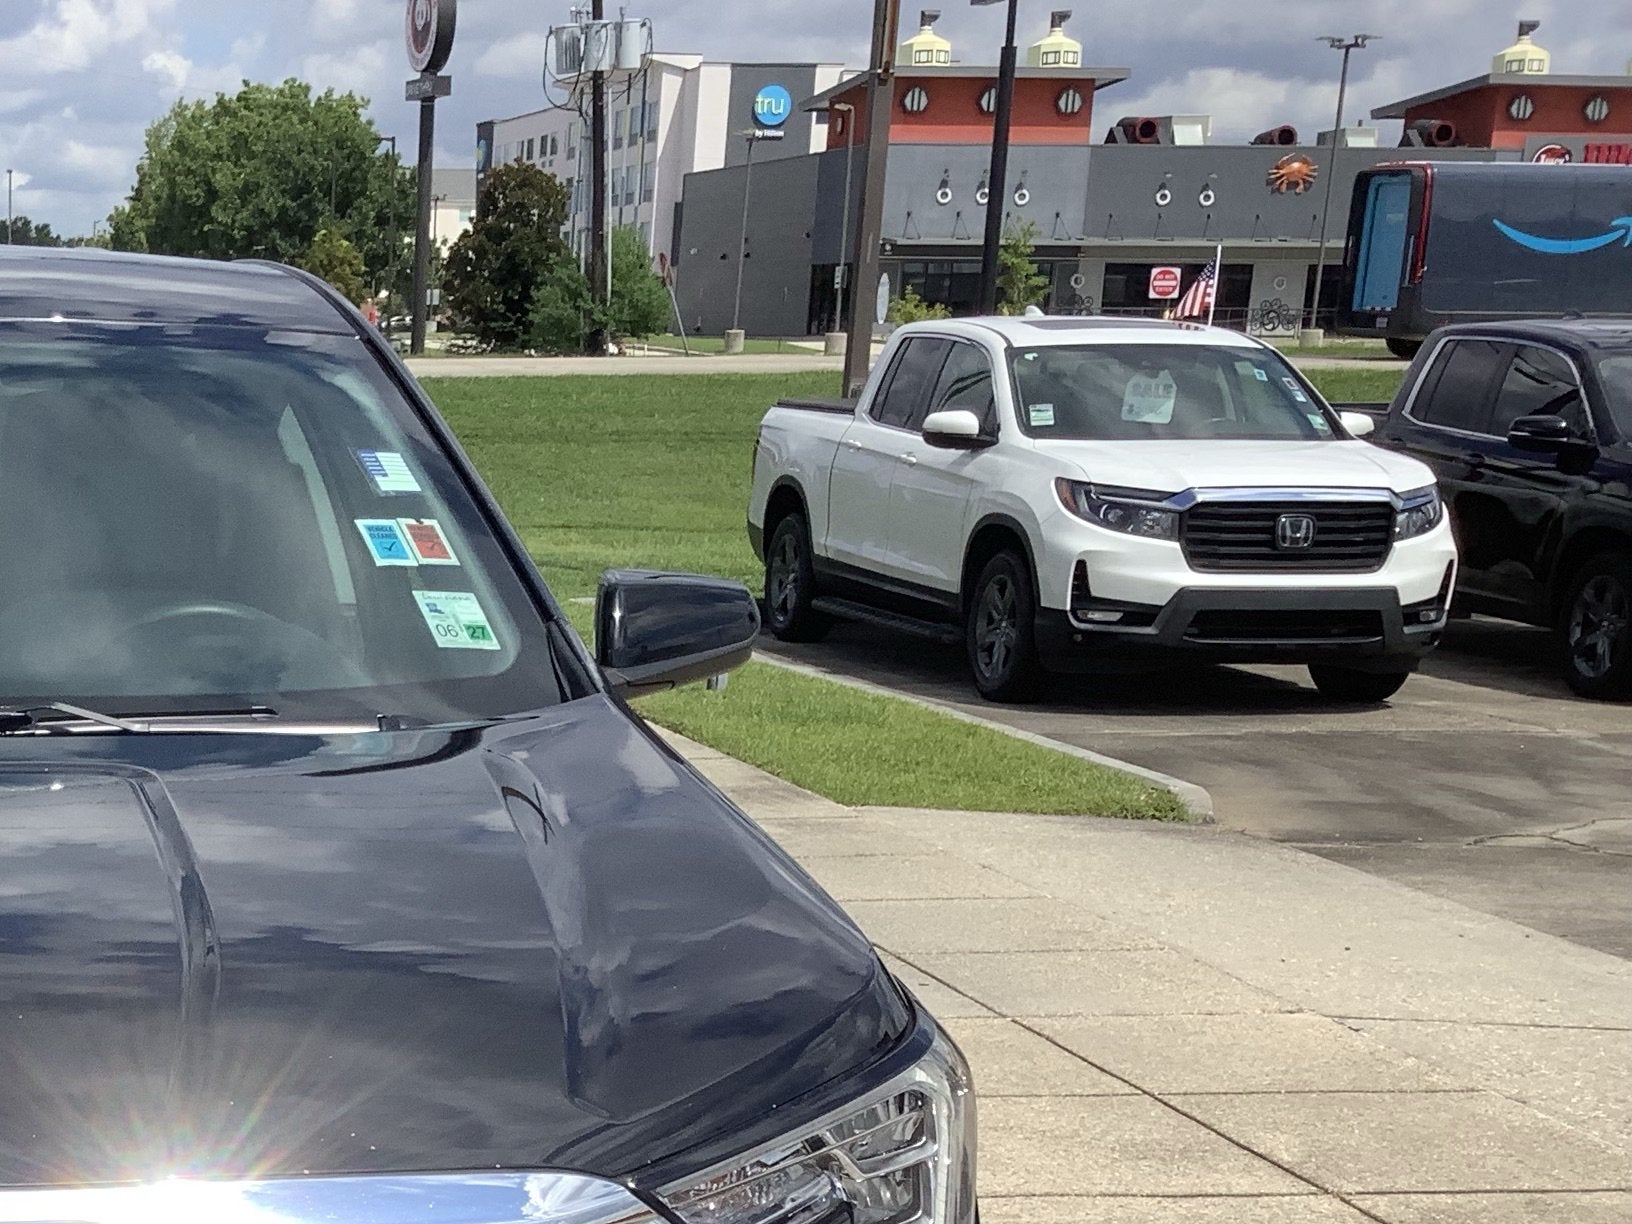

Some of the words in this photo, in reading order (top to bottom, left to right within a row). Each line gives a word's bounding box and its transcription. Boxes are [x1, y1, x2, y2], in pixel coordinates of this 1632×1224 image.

[755, 95, 785, 115] tru
[435, 623, 459, 638] 06
[467, 625, 486, 640] 27
